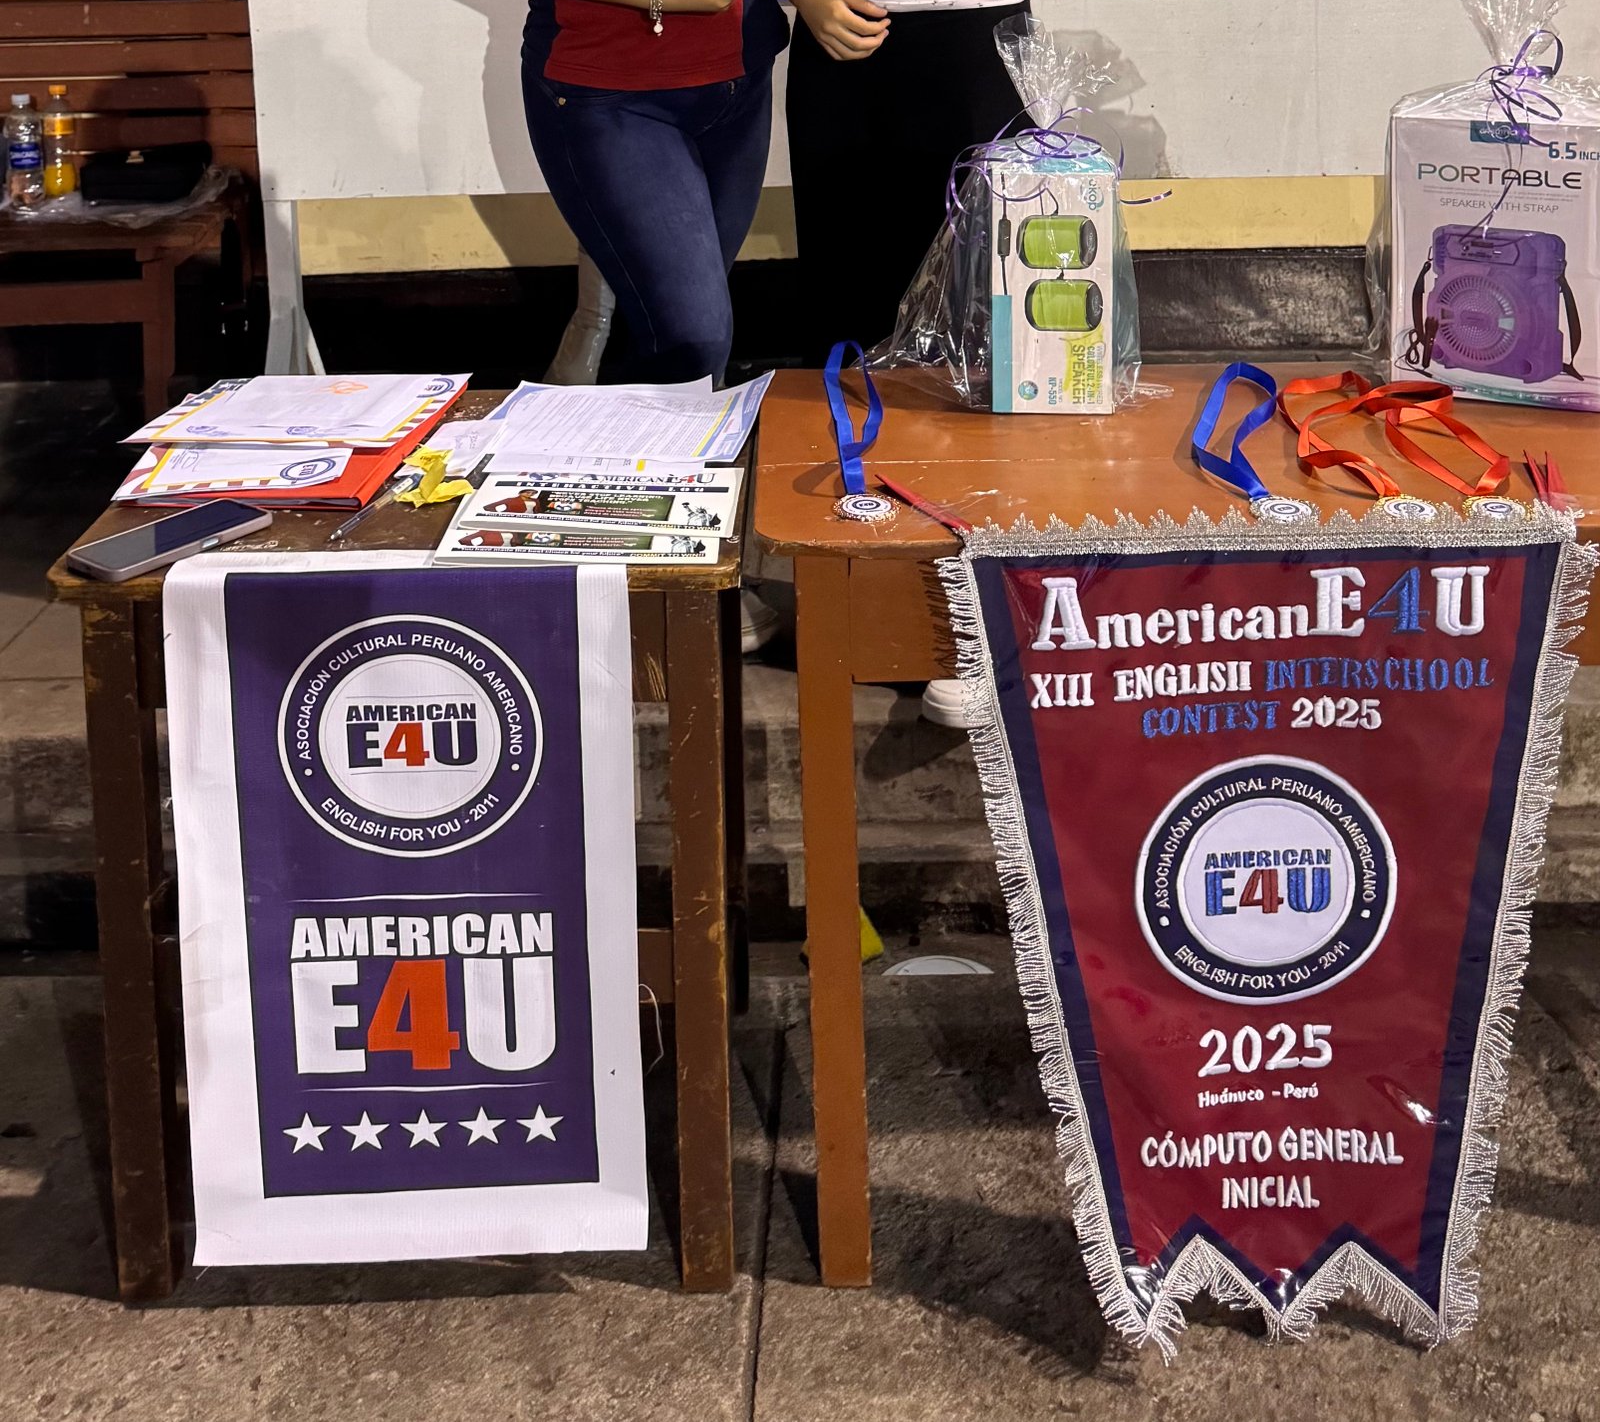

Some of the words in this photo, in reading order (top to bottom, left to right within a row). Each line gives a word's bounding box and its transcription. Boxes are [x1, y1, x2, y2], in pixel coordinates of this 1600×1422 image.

[1548, 141, 1578, 160] 6.5
[1417, 162, 1583, 190] PORTABLE
[1439, 197, 1486, 209] SPEAKER
[1523, 202, 1559, 213] STRAP
[1072, 344, 1086, 405] SPEAKER
[1086, 345, 1096, 382] COLORFUL
[1086, 382, 1096, 405] 2-IN-1
[515, 481, 648, 492] INTERACTIVE
[296, 669, 332, 760] ASOCIACIÓN
[328, 633, 407, 672] CULTURAL
[410, 633, 487, 671] PERUANO
[482, 670, 524, 756] AMERICANO
[1029, 671, 1095, 709] XIII
[1112, 659, 1253, 703] ENGLISH
[1263, 656, 1496, 694] INTERSCHOOL
[345, 702, 477, 723] AMERICAN
[1140, 699, 1281, 739] CONTEST
[1290, 695, 1383, 731] 2025
[346, 720, 478, 769] E4U
[320, 797, 387, 839] ENGLISH
[389, 826, 425, 841] FOR
[426, 818, 462, 840] YOU
[467, 793, 500, 822] 2011
[1155, 816, 1194, 910] ASOCIACIÓN
[1190, 776, 1267, 820] CULTURAL
[1270, 776, 1343, 817] PERUANO
[1337, 814, 1377, 903] AMERICANO
[1203, 848, 1332, 870] AMERICAN
[1204, 866, 1332, 917] E4U
[290, 912, 554, 959] AMERICAN
[1173, 944, 1238, 988] ENGLISH
[1238, 974, 1275, 990] FOR
[1276, 965, 1311, 988] YOU
[1318, 940, 1351, 971] 2011
[290, 955, 557, 1074] E4U
[1197, 1022, 1333, 1078] 2025
[1197, 1087, 1265, 1109] Huánuco
[1139, 1129, 1273, 1169] CÓMPUTO
[1277, 1125, 1404, 1166] GENERAL
[1221, 1174, 1320, 1210] INICIAL
